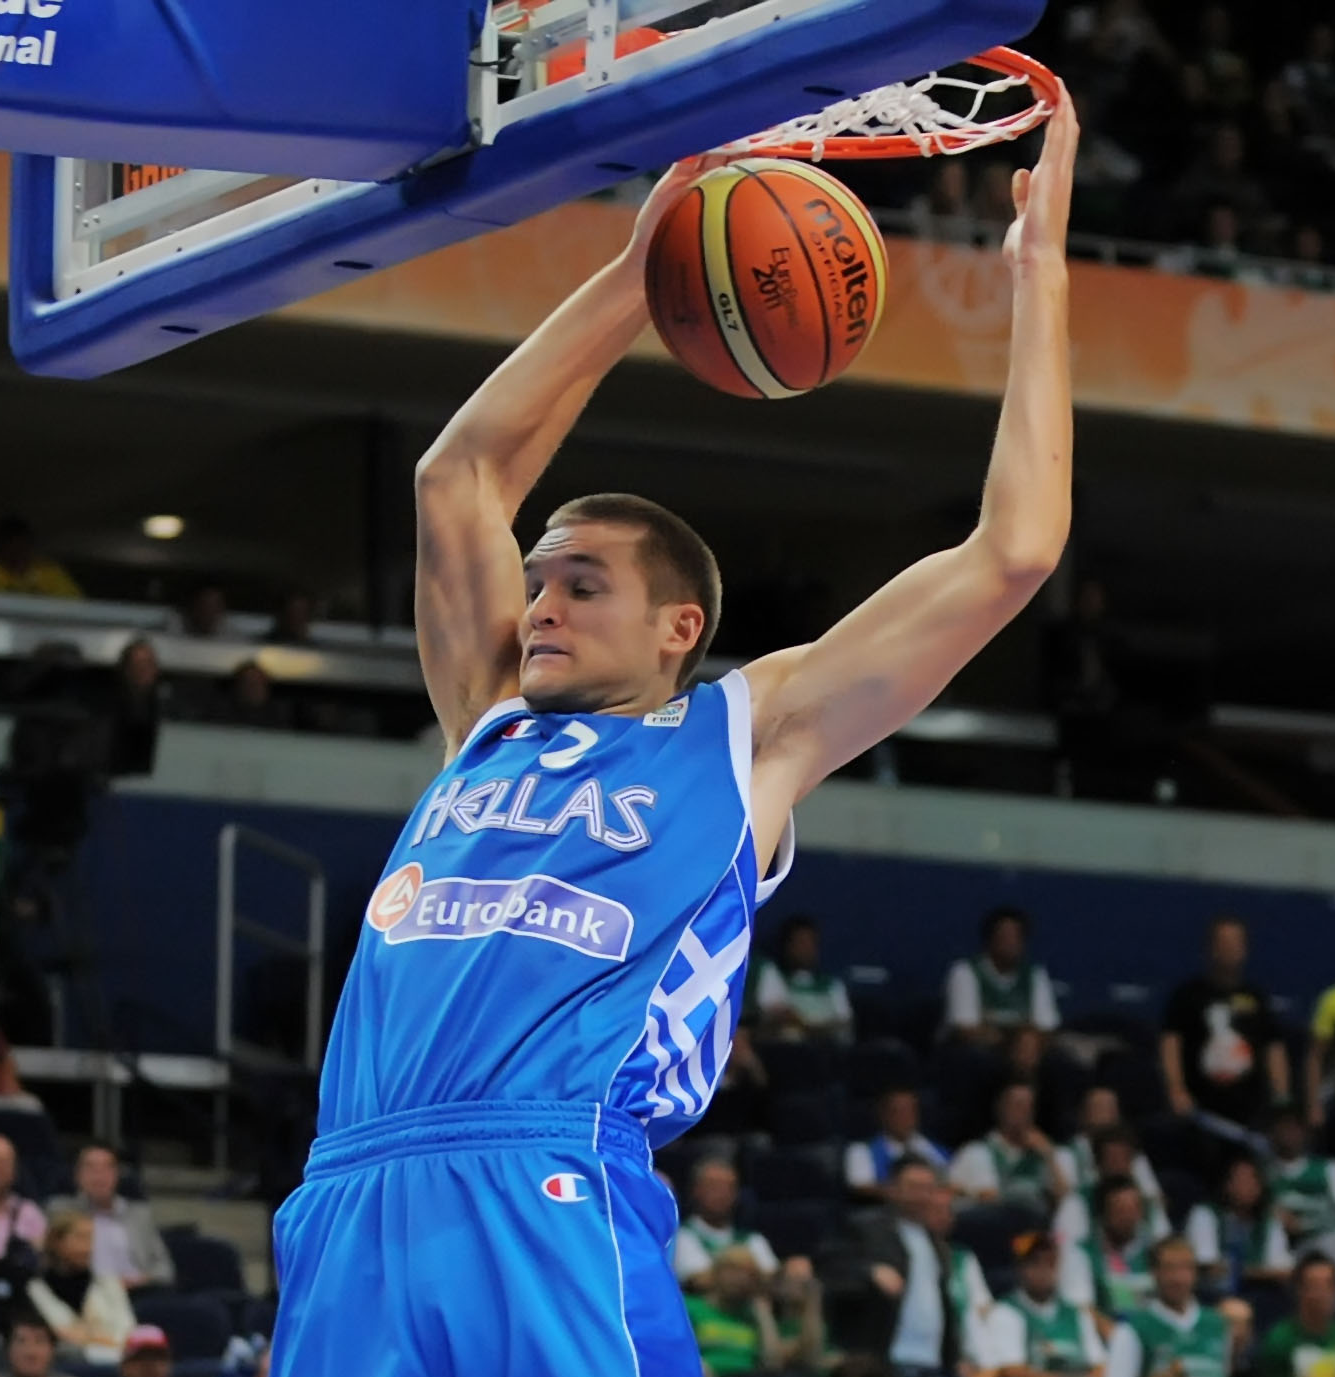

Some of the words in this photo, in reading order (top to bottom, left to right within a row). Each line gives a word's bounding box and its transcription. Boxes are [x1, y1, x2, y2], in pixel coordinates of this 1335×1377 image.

[752, 265, 782, 310] 2011
[804, 198, 870, 346] molten
[718, 292, 740, 332] GL7
[411, 773, 659, 852] HELLAS
[416, 892, 606, 945] Eurobank
